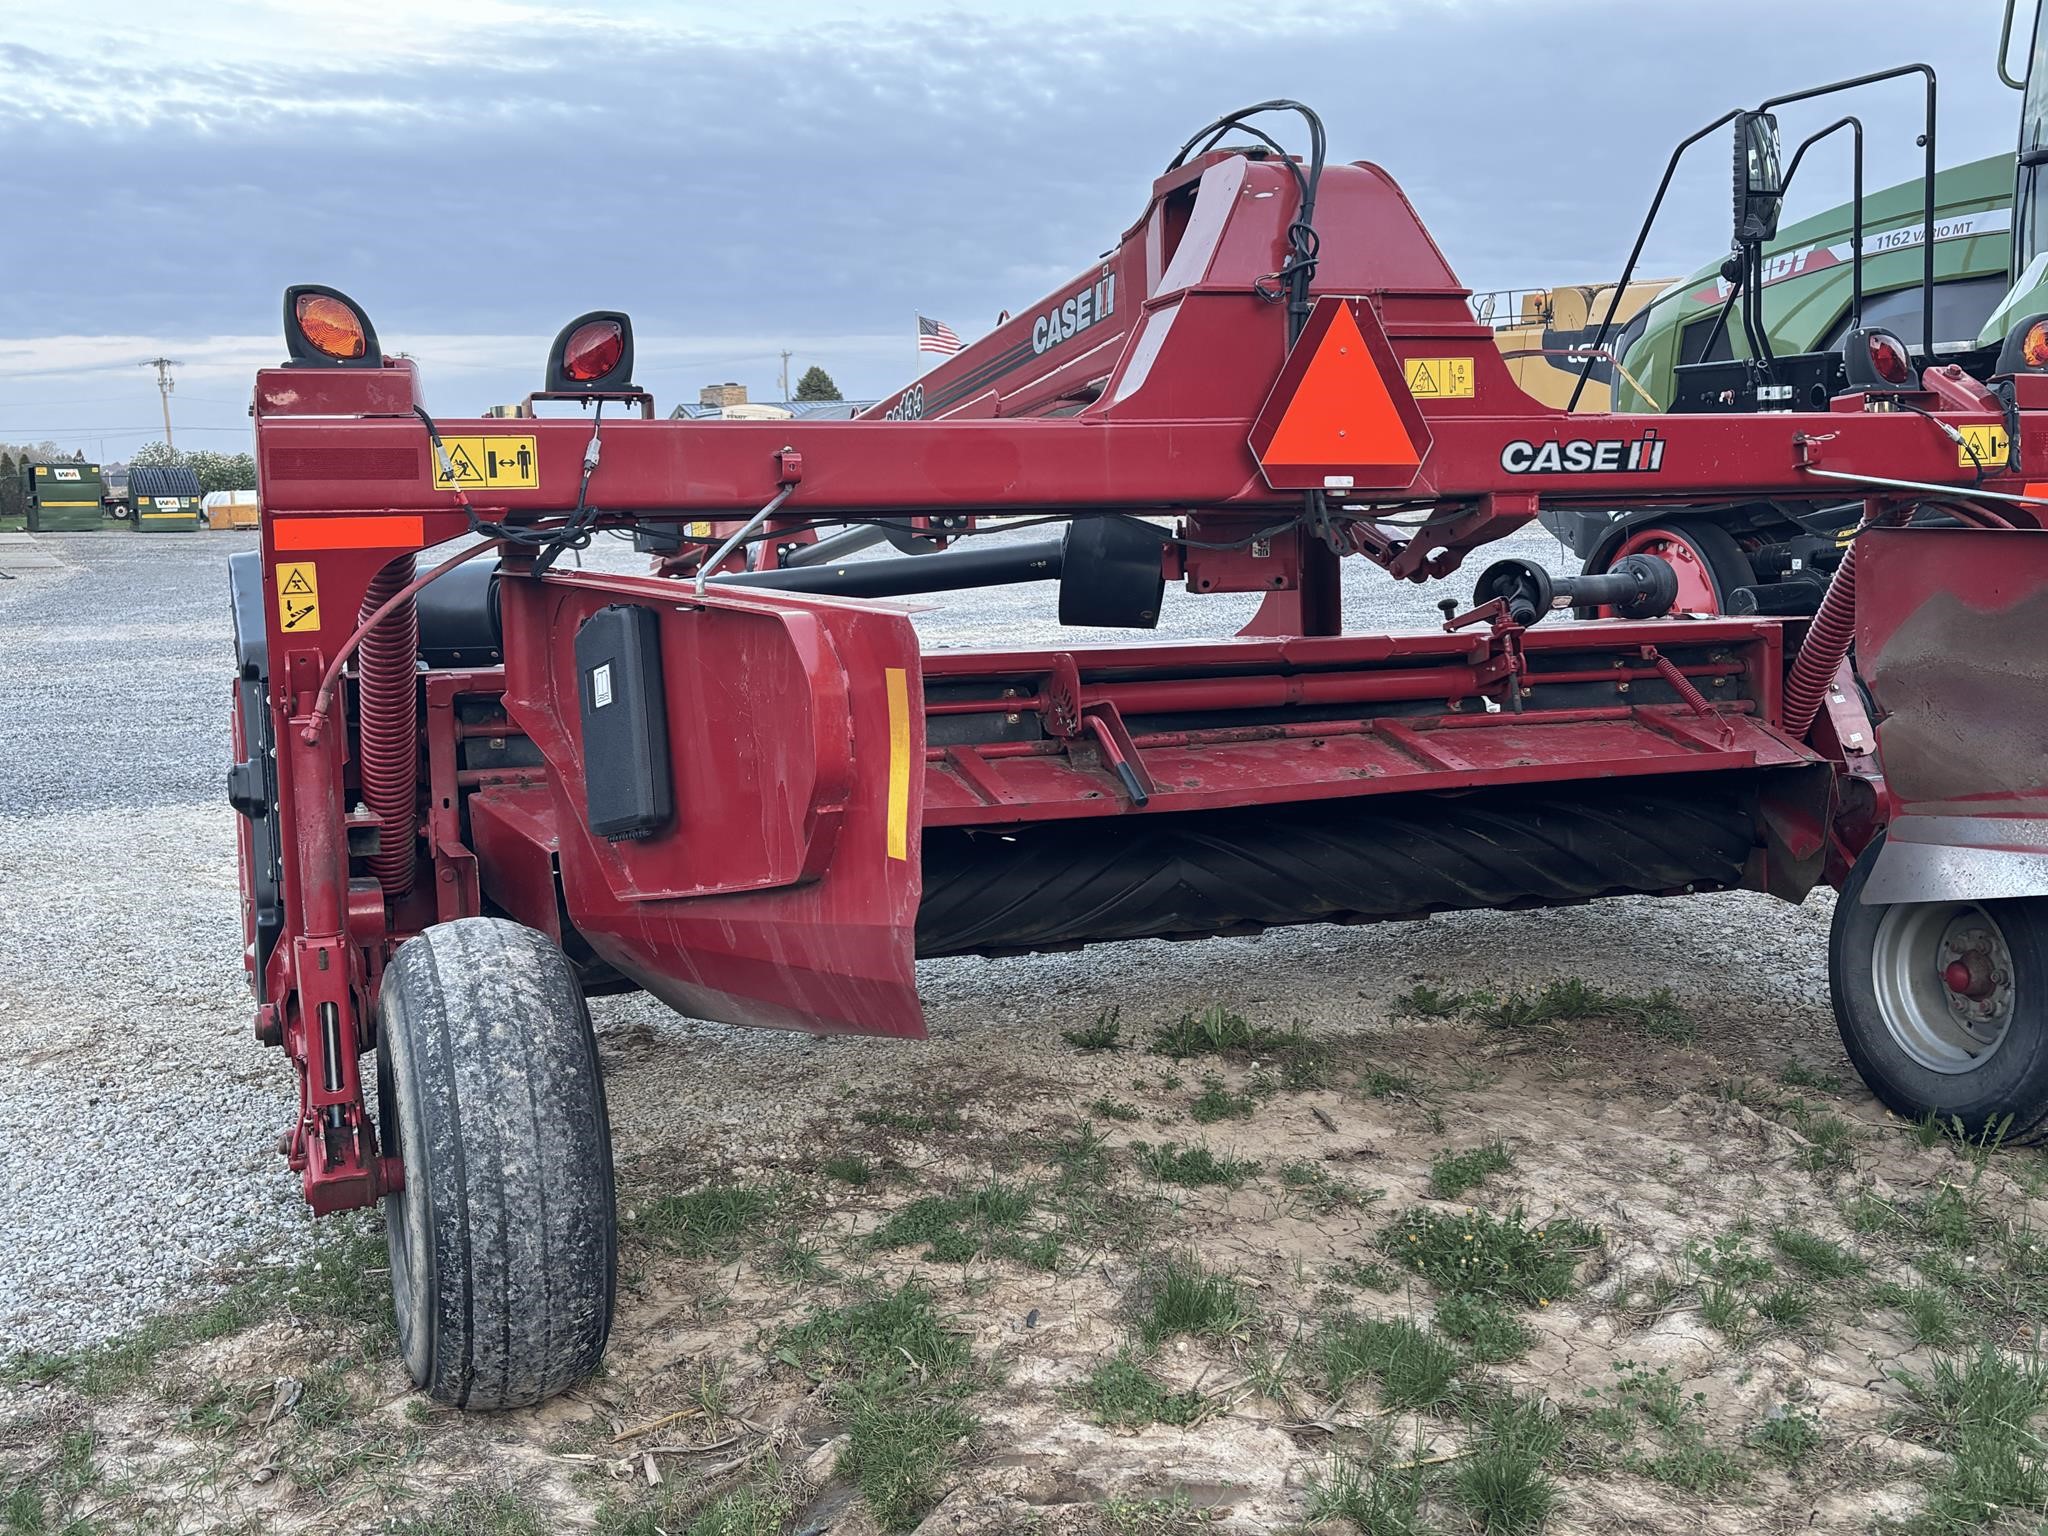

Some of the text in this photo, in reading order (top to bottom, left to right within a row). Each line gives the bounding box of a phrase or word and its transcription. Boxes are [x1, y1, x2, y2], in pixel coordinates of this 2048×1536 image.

[1876, 230, 1911, 250] 1162
[1952, 221, 1974, 235] MT
[1032, 286, 1092, 354] CASE
[1501, 440, 1623, 474] CASE
